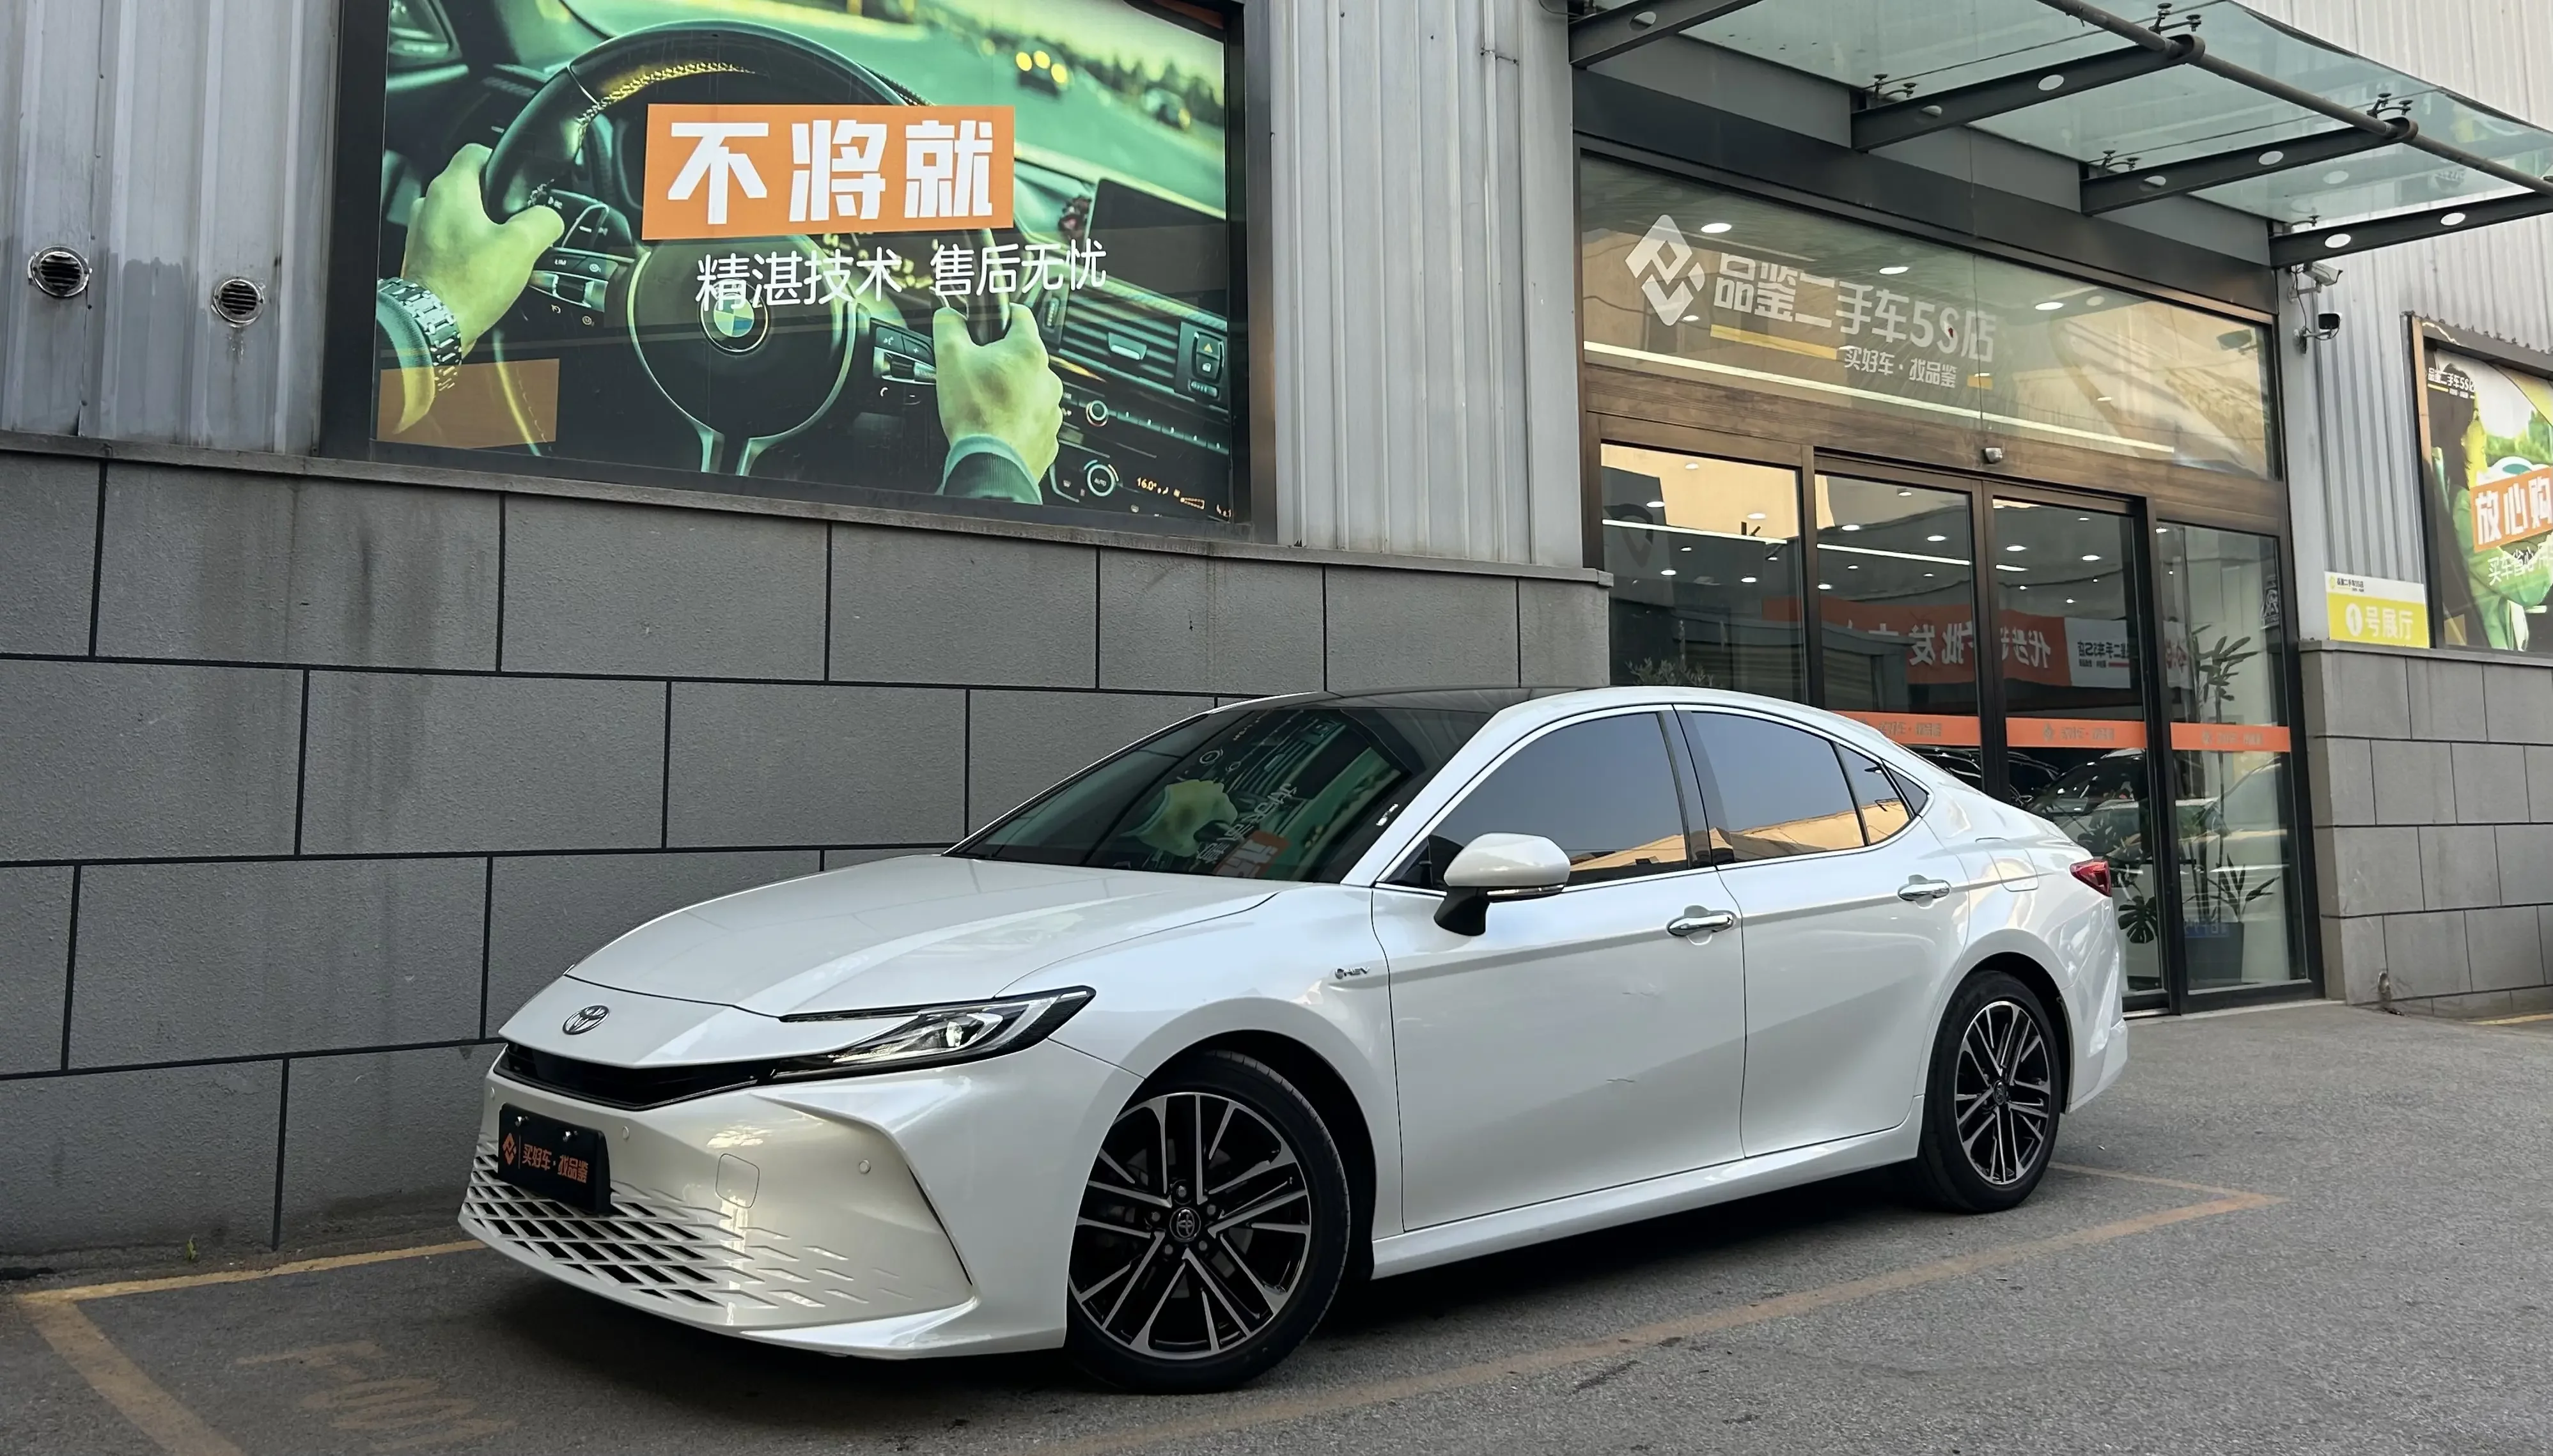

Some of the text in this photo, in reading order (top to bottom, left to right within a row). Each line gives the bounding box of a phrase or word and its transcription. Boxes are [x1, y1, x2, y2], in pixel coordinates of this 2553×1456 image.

[668, 119, 993, 224] 不将就
[696, 238, 1107, 312] 精湛技术 售后无忧
[1714, 253, 1996, 362] 品鉴二手车5S店
